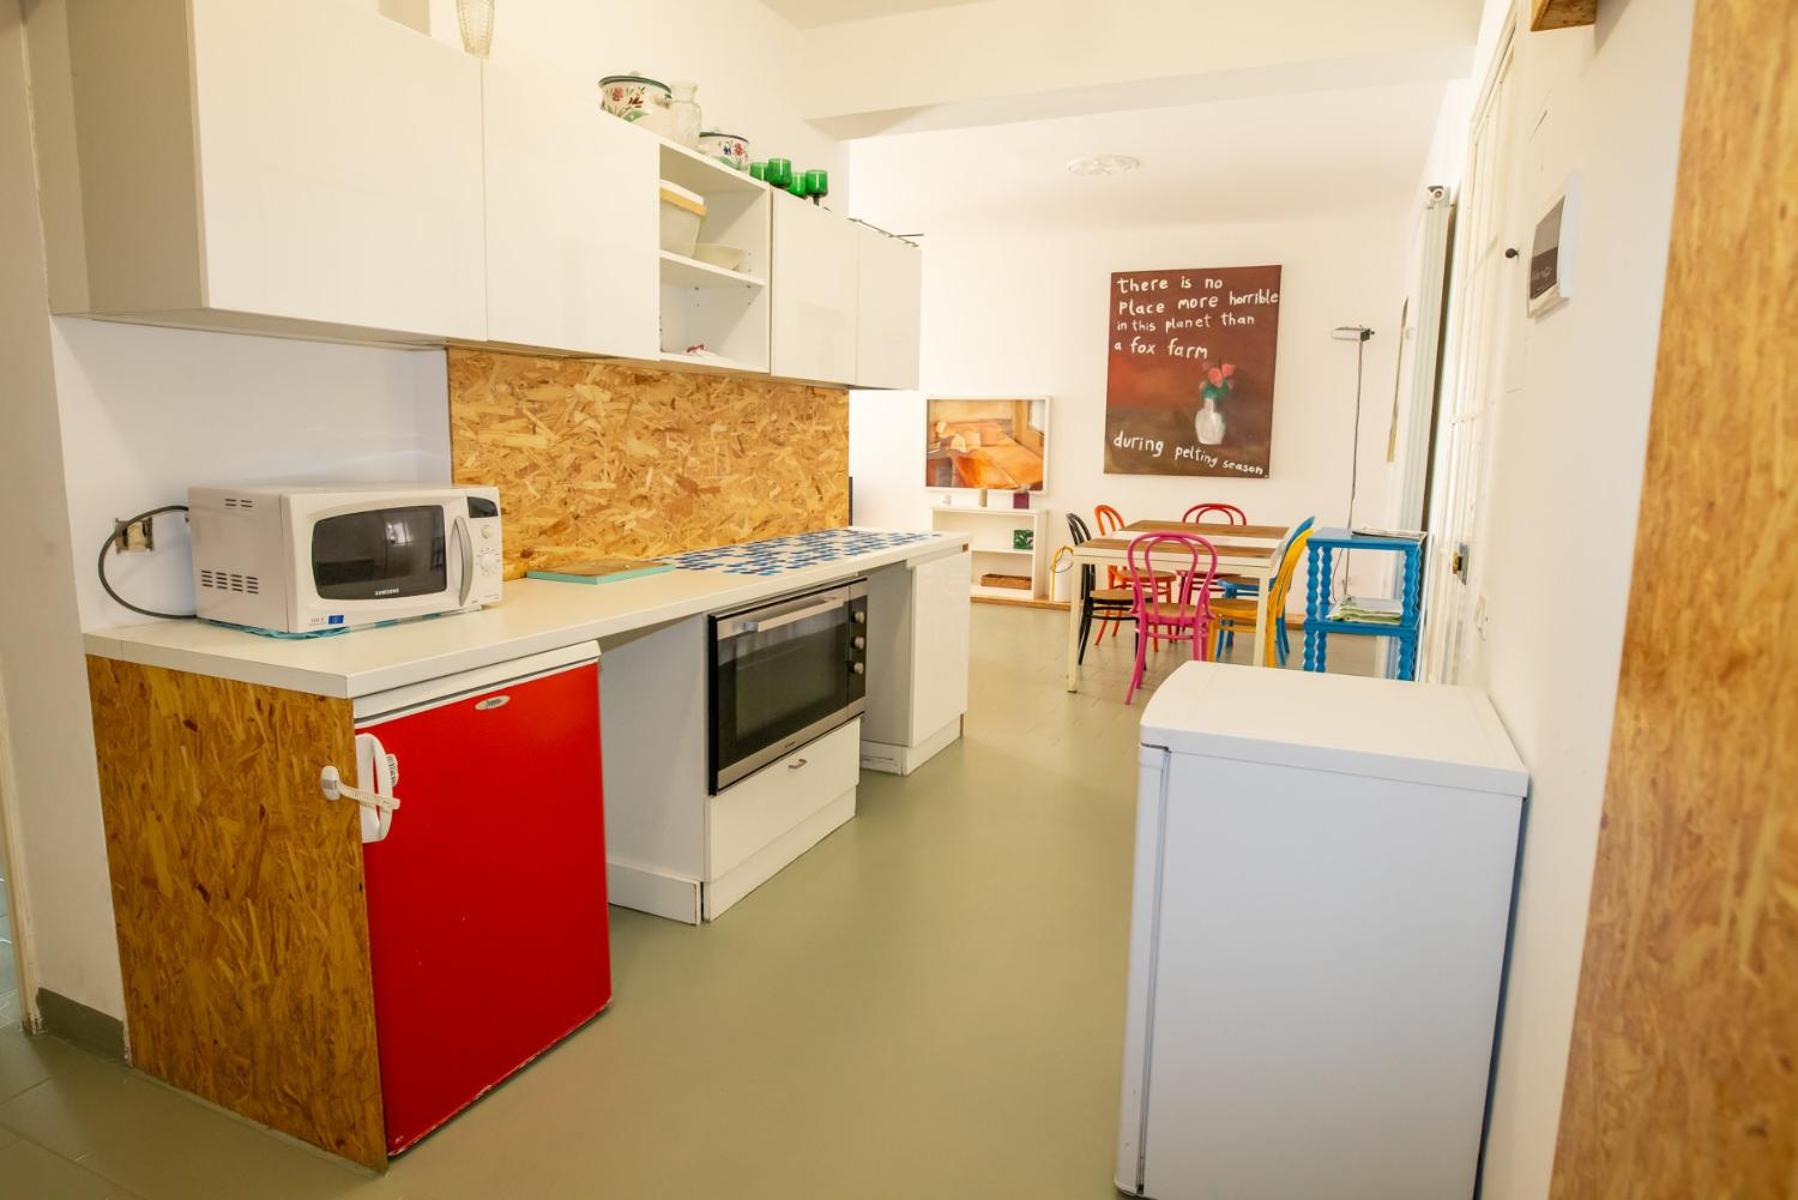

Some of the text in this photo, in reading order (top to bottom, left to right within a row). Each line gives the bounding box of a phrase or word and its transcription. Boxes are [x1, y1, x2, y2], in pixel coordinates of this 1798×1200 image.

[1117, 275, 1223, 294] there is no
[1178, 296, 1219, 310] more
[1229, 288, 1279, 306] horrible
[1117, 312, 1255, 333] in this planet than
[1114, 336, 1208, 359] a fox farm
[1113, 430, 1164, 457] during
[1175, 446, 1218, 468] pelting
